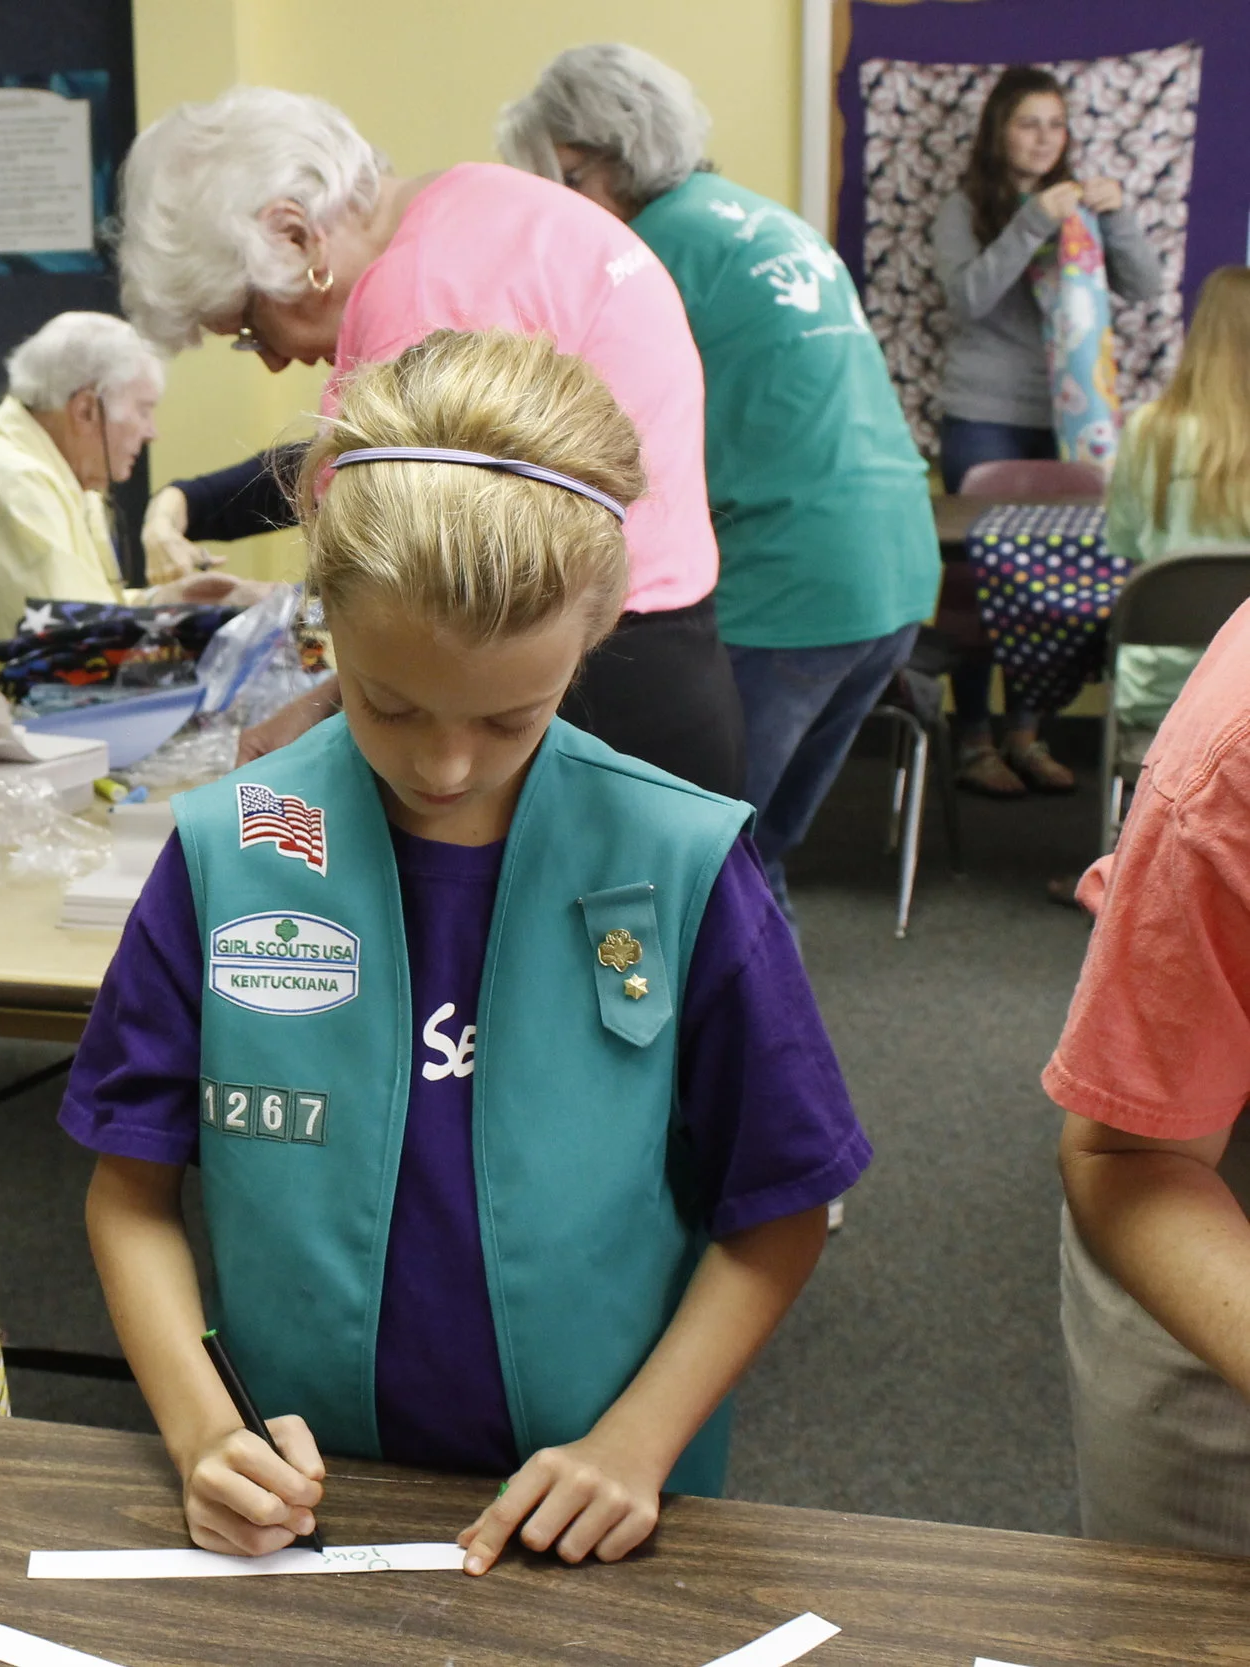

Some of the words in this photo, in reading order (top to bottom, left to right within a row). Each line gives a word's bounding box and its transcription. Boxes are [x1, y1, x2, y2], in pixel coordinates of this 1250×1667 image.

[216, 939, 253, 955] GIRL
[255, 941, 320, 959] SCOUTS
[323, 944, 353, 960] USA
[230, 974, 339, 992] KENTUCKIANA
[205, 1085, 323, 1136] 1267
